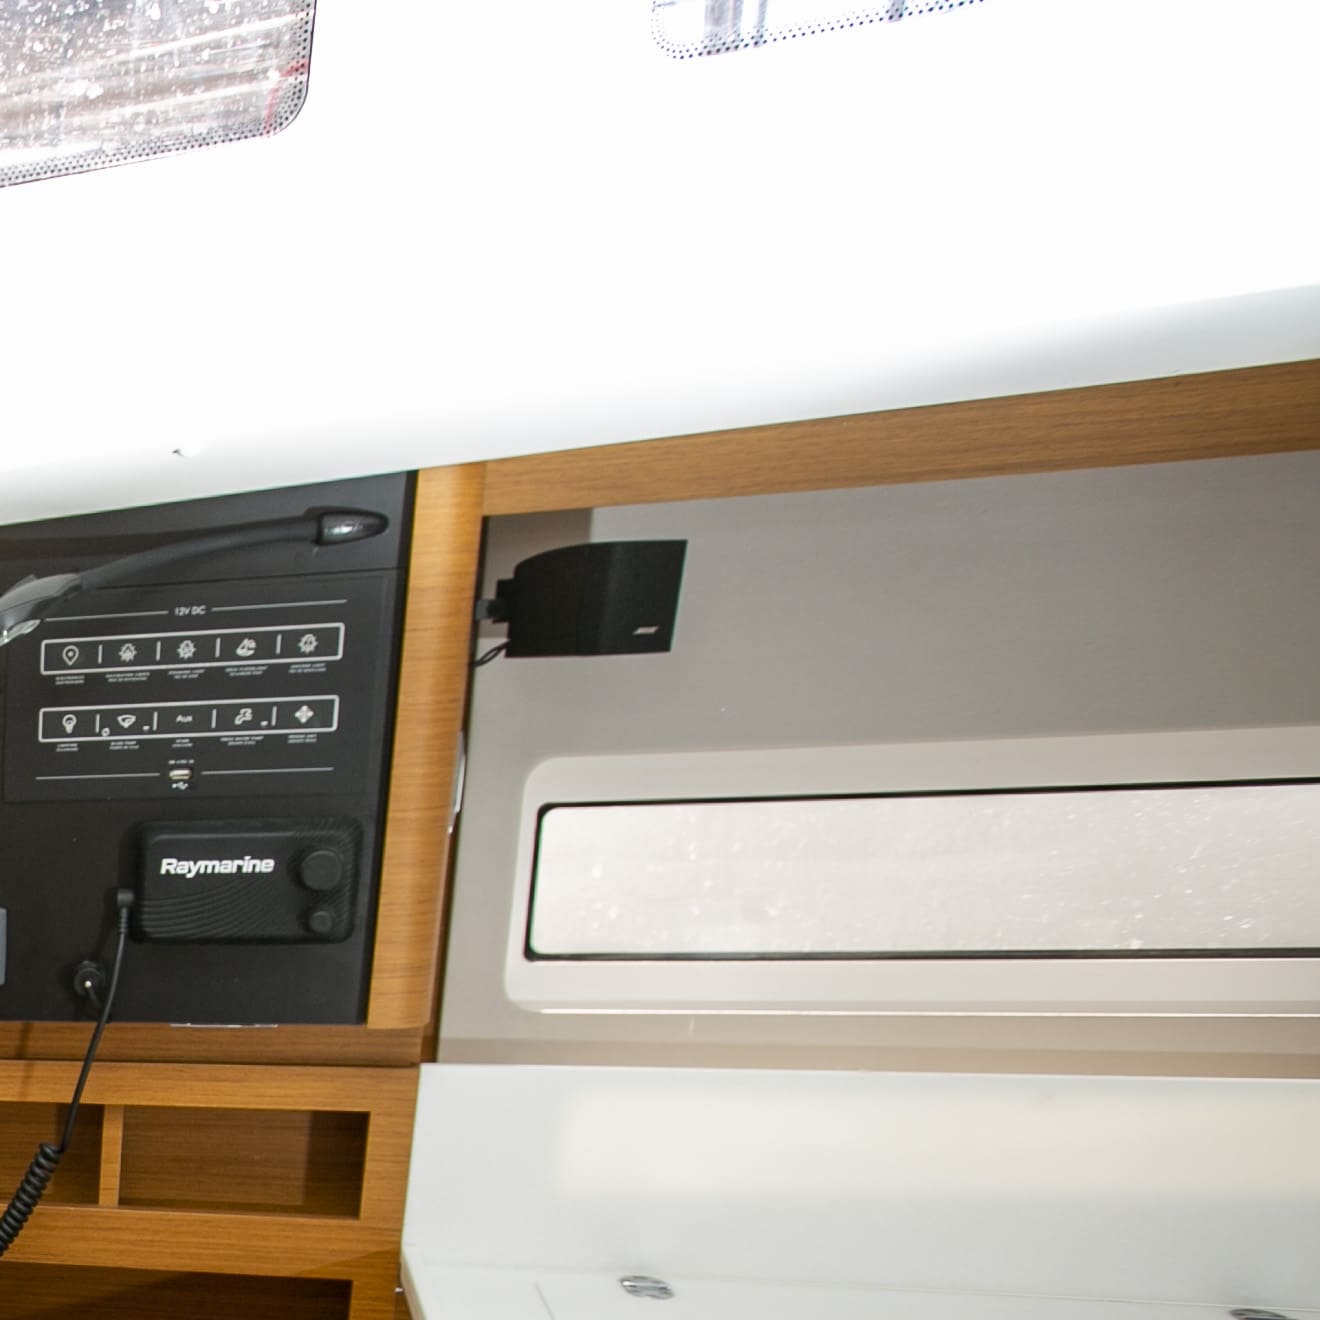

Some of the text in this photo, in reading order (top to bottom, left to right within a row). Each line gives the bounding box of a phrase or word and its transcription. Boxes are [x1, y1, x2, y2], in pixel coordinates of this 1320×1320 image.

[191, 604, 208, 616] DC
[175, 714, 193, 723] Aux
[160, 856, 275, 878] Raymarine
